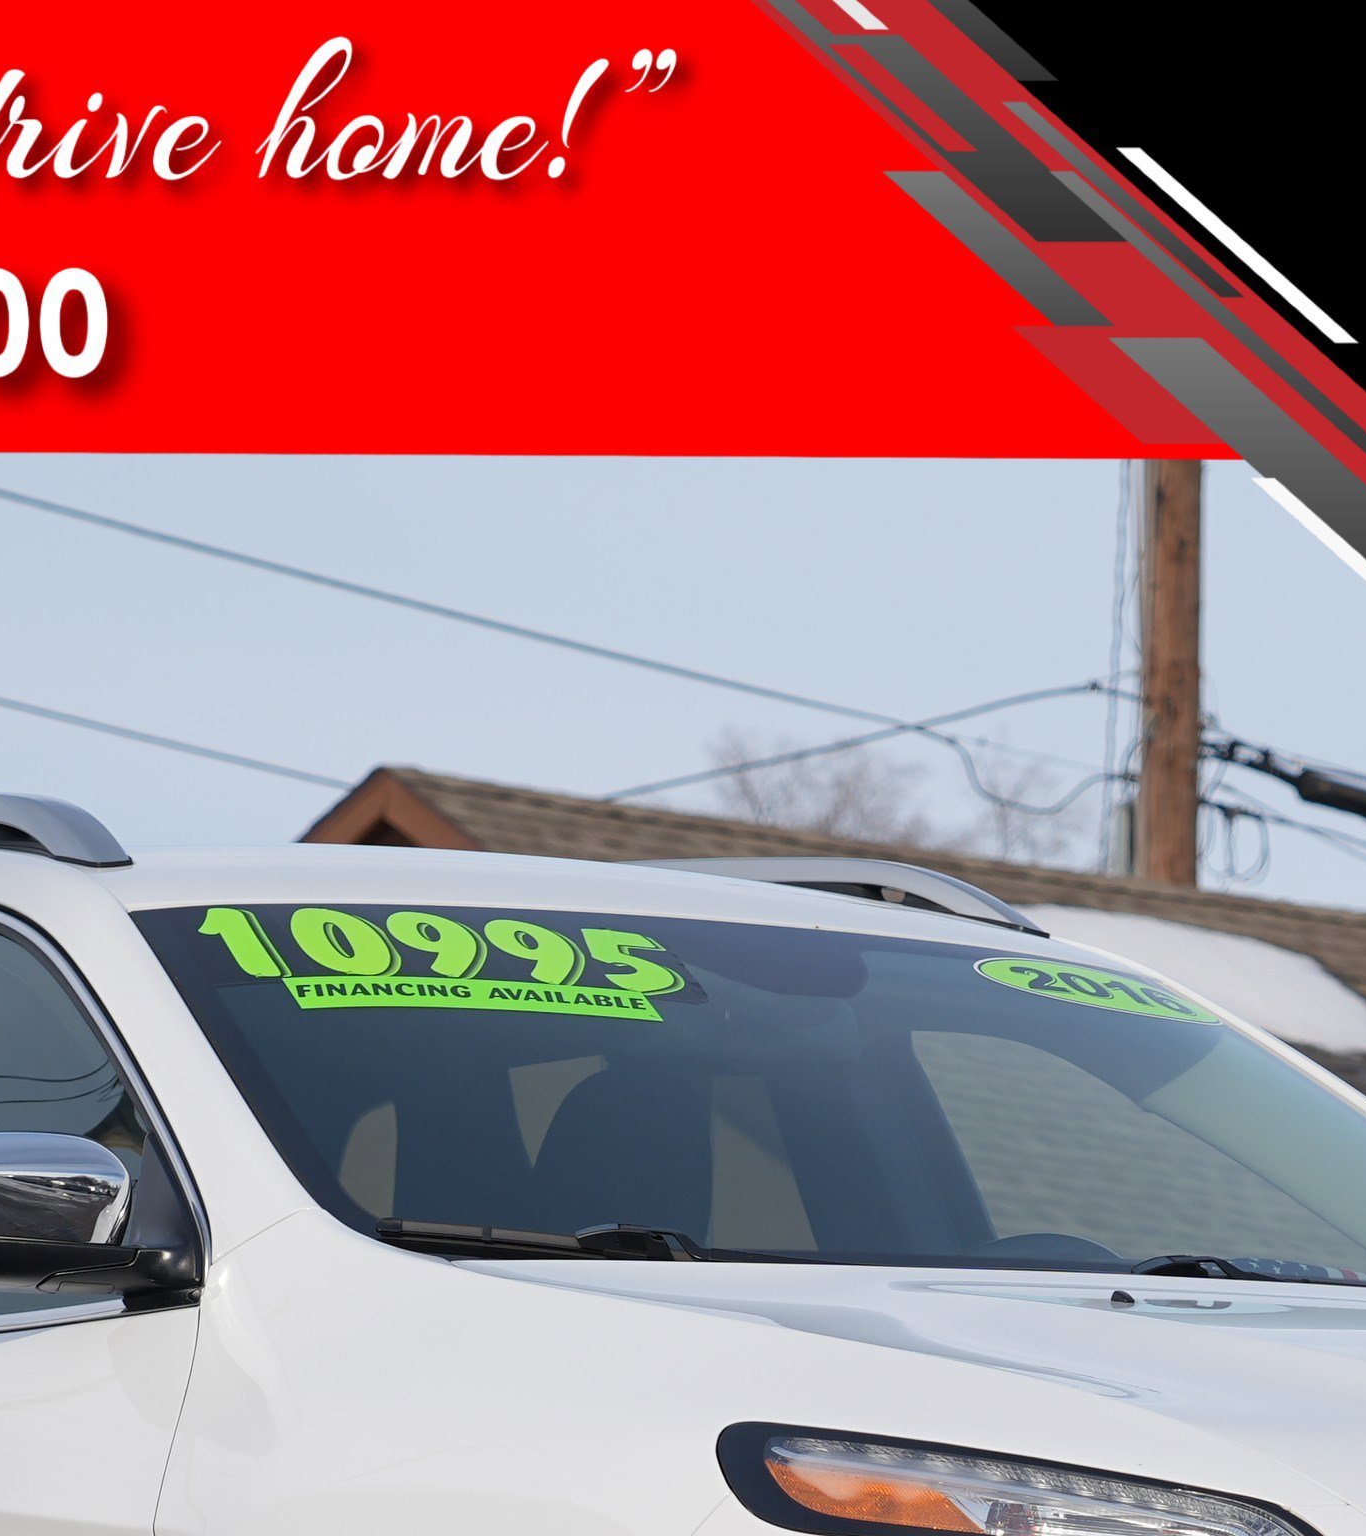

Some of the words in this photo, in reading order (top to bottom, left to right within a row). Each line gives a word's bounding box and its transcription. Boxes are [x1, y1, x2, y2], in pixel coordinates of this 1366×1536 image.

[197, 907, 685, 997] 10995
[295, 982, 472, 999] FINANCING
[488, 987, 647, 1011] AVAILABLE
[1009, 965, 1198, 1017] 2016
